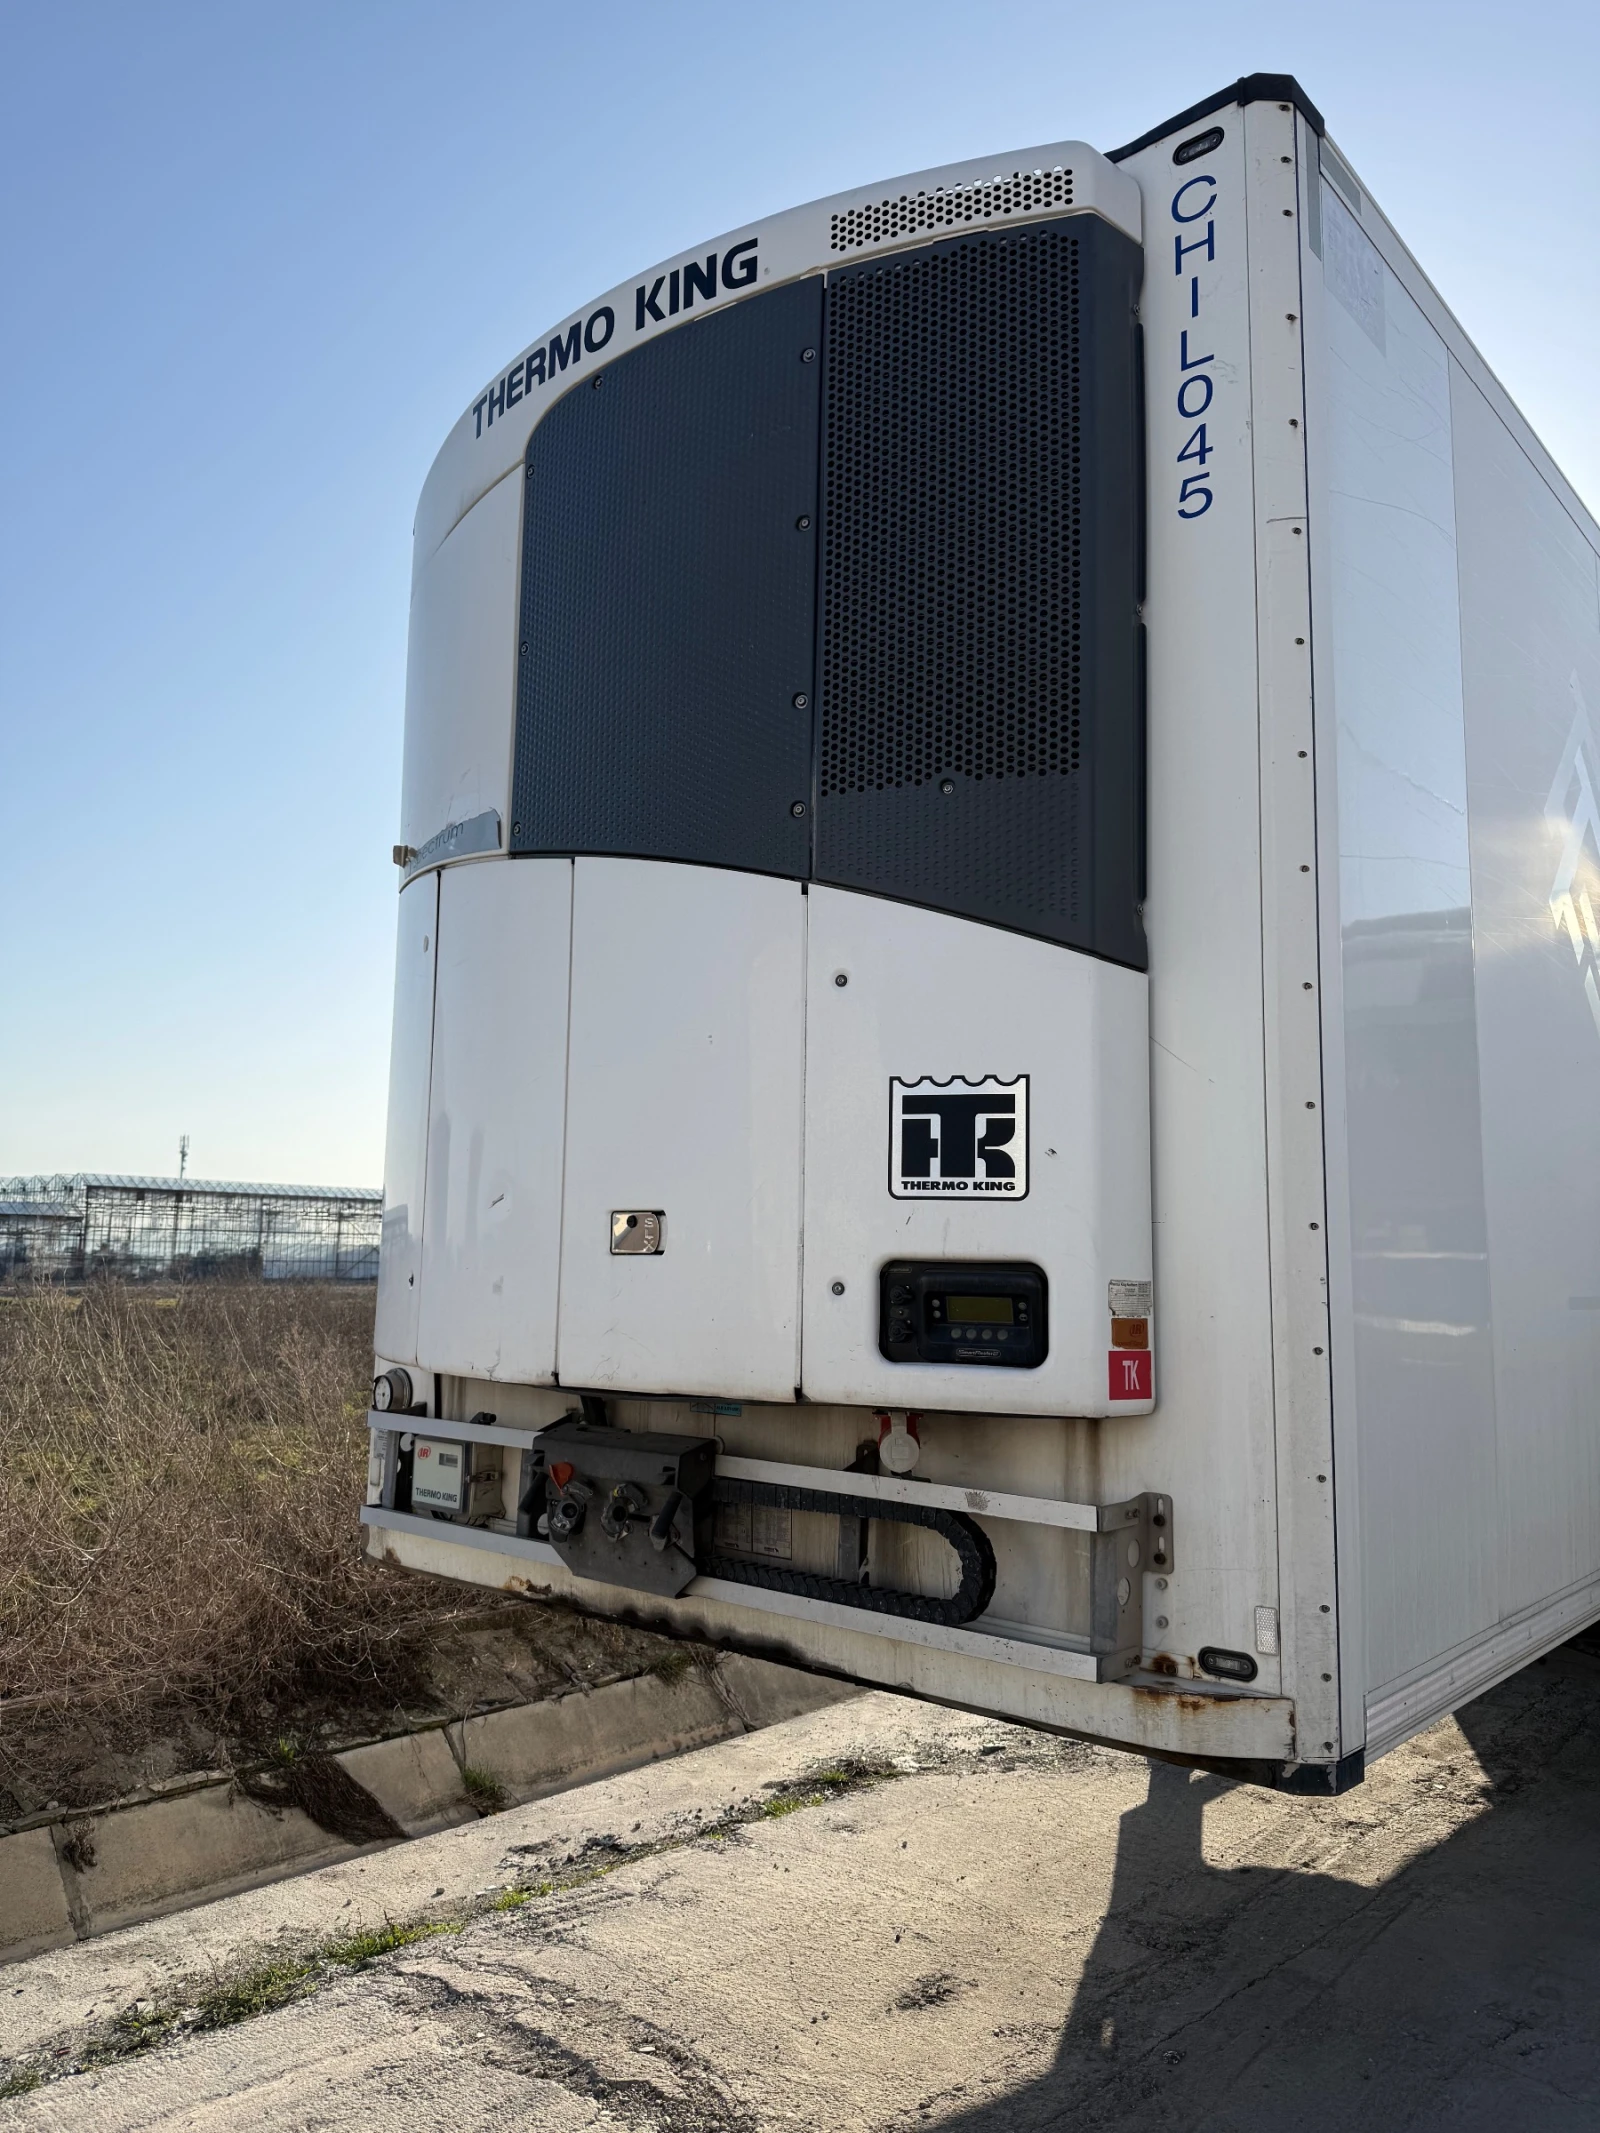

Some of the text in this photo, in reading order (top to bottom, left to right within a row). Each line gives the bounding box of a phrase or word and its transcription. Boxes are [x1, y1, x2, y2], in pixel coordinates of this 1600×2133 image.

[472, 237, 759, 439] THERMO KING
[901, 1180, 1016, 1192] THERMO KING
[643, 1217, 656, 1252] SLX
[1122, 1360, 1140, 1390] TK
[418, 1446, 430, 1459] IR
[415, 1486, 458, 1503] THERMO KING
